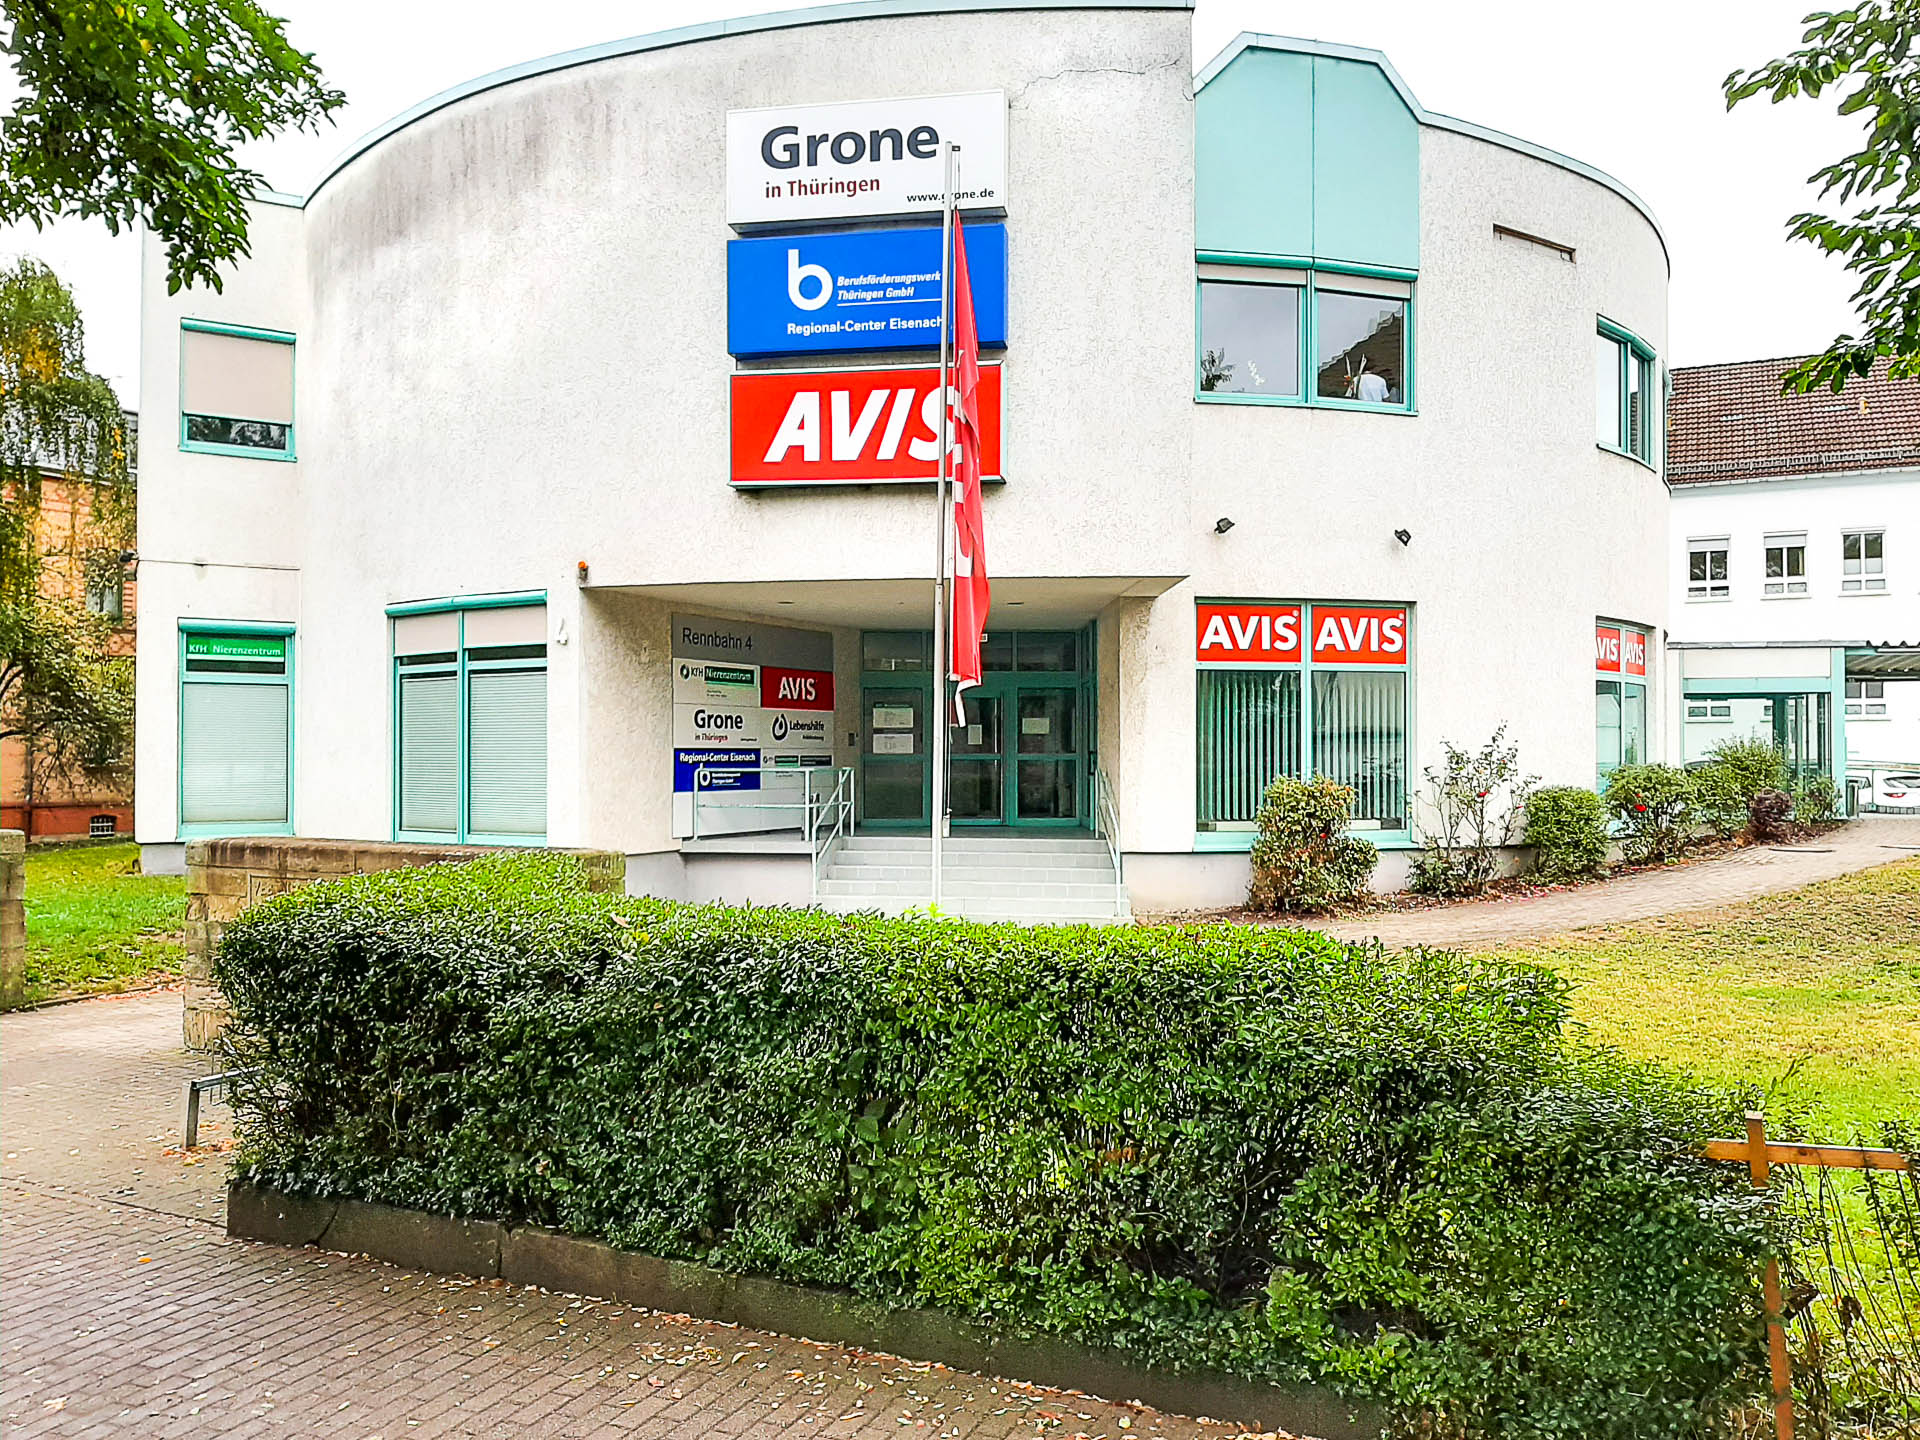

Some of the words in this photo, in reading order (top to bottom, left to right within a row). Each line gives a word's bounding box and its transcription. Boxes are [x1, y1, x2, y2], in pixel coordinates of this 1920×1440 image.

[760, 125, 940, 170] Grone
[765, 181, 782, 199] in
[786, 176, 881, 199] Thüringen
[837, 271, 942, 287] Berufsförderungswerk
[837, 289, 884, 302] Thüringen
[885, 286, 915, 298] GmbH
[787, 320, 887, 337] Regional-Center
[763, 384, 957, 463] AVIS
[682, 627, 742, 649] Rennbahn
[745, 636, 753, 651] 4
[1199, 614, 1299, 651] AVIS
[1314, 616, 1404, 653] AVIS
[189, 644, 207, 653] KfH
[212, 645, 281, 656] Nierenzentrum
[1625, 641, 1644, 666] AVIS
[705, 667, 752, 681] Nierenzentrum
[778, 677, 817, 701] AVIS
[694, 709, 744, 729] Grone
[789, 720, 825, 732] Lebenshilfe
[679, 752, 729, 764] Regional-Center
[730, 752, 756, 762] Eisenach
